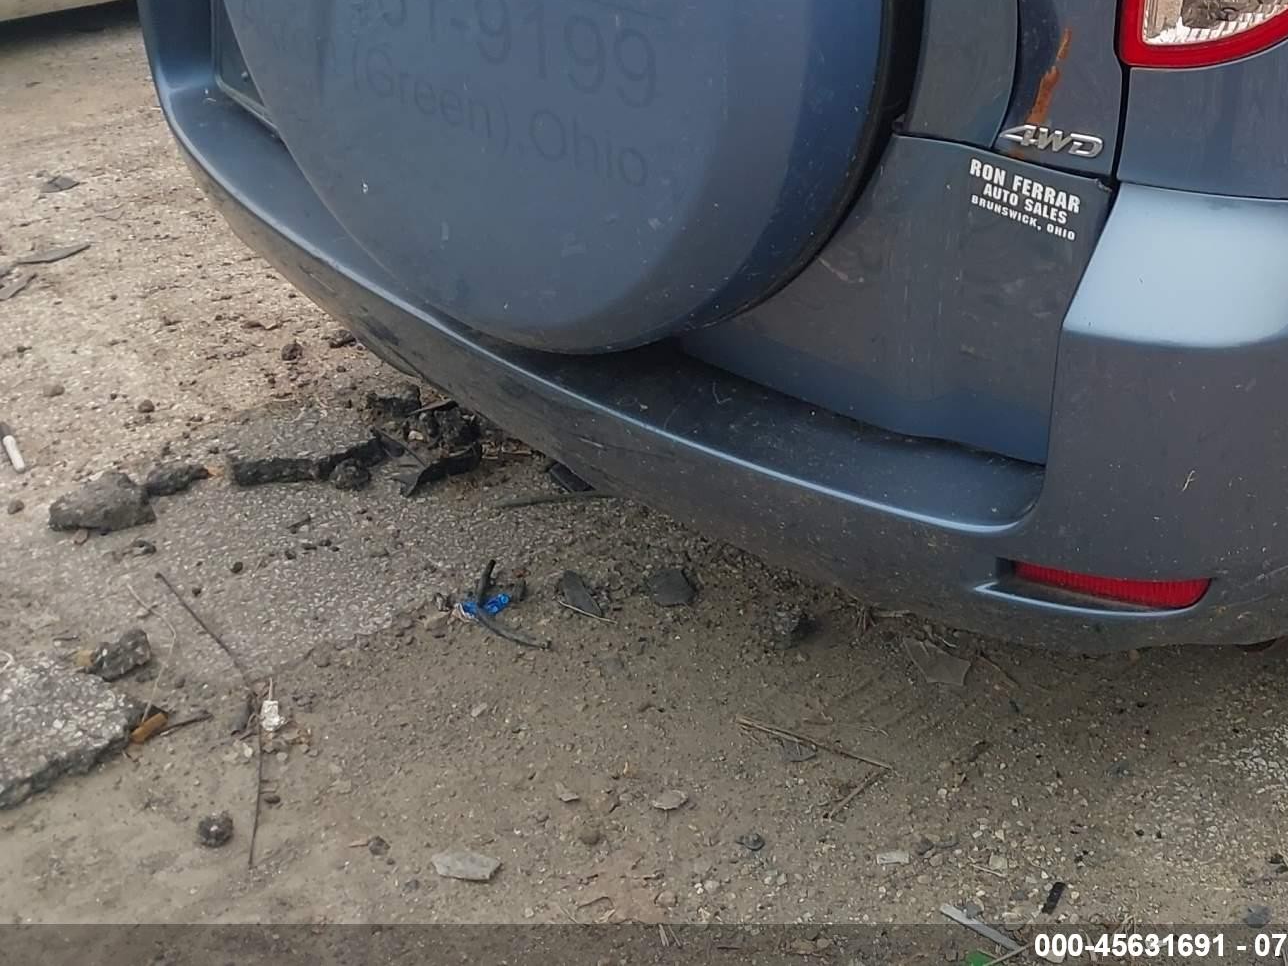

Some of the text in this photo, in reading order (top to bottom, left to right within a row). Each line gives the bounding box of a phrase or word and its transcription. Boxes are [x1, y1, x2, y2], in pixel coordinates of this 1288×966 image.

[529, 108, 649, 188] Ohio
[1000, 123, 1104, 158] 4WD
[970, 158, 1081, 213] RON FERRAR
[983, 183, 1068, 224] AUTO SALES
[971, 195, 1075, 241] BRUNSWICK, OHIO
